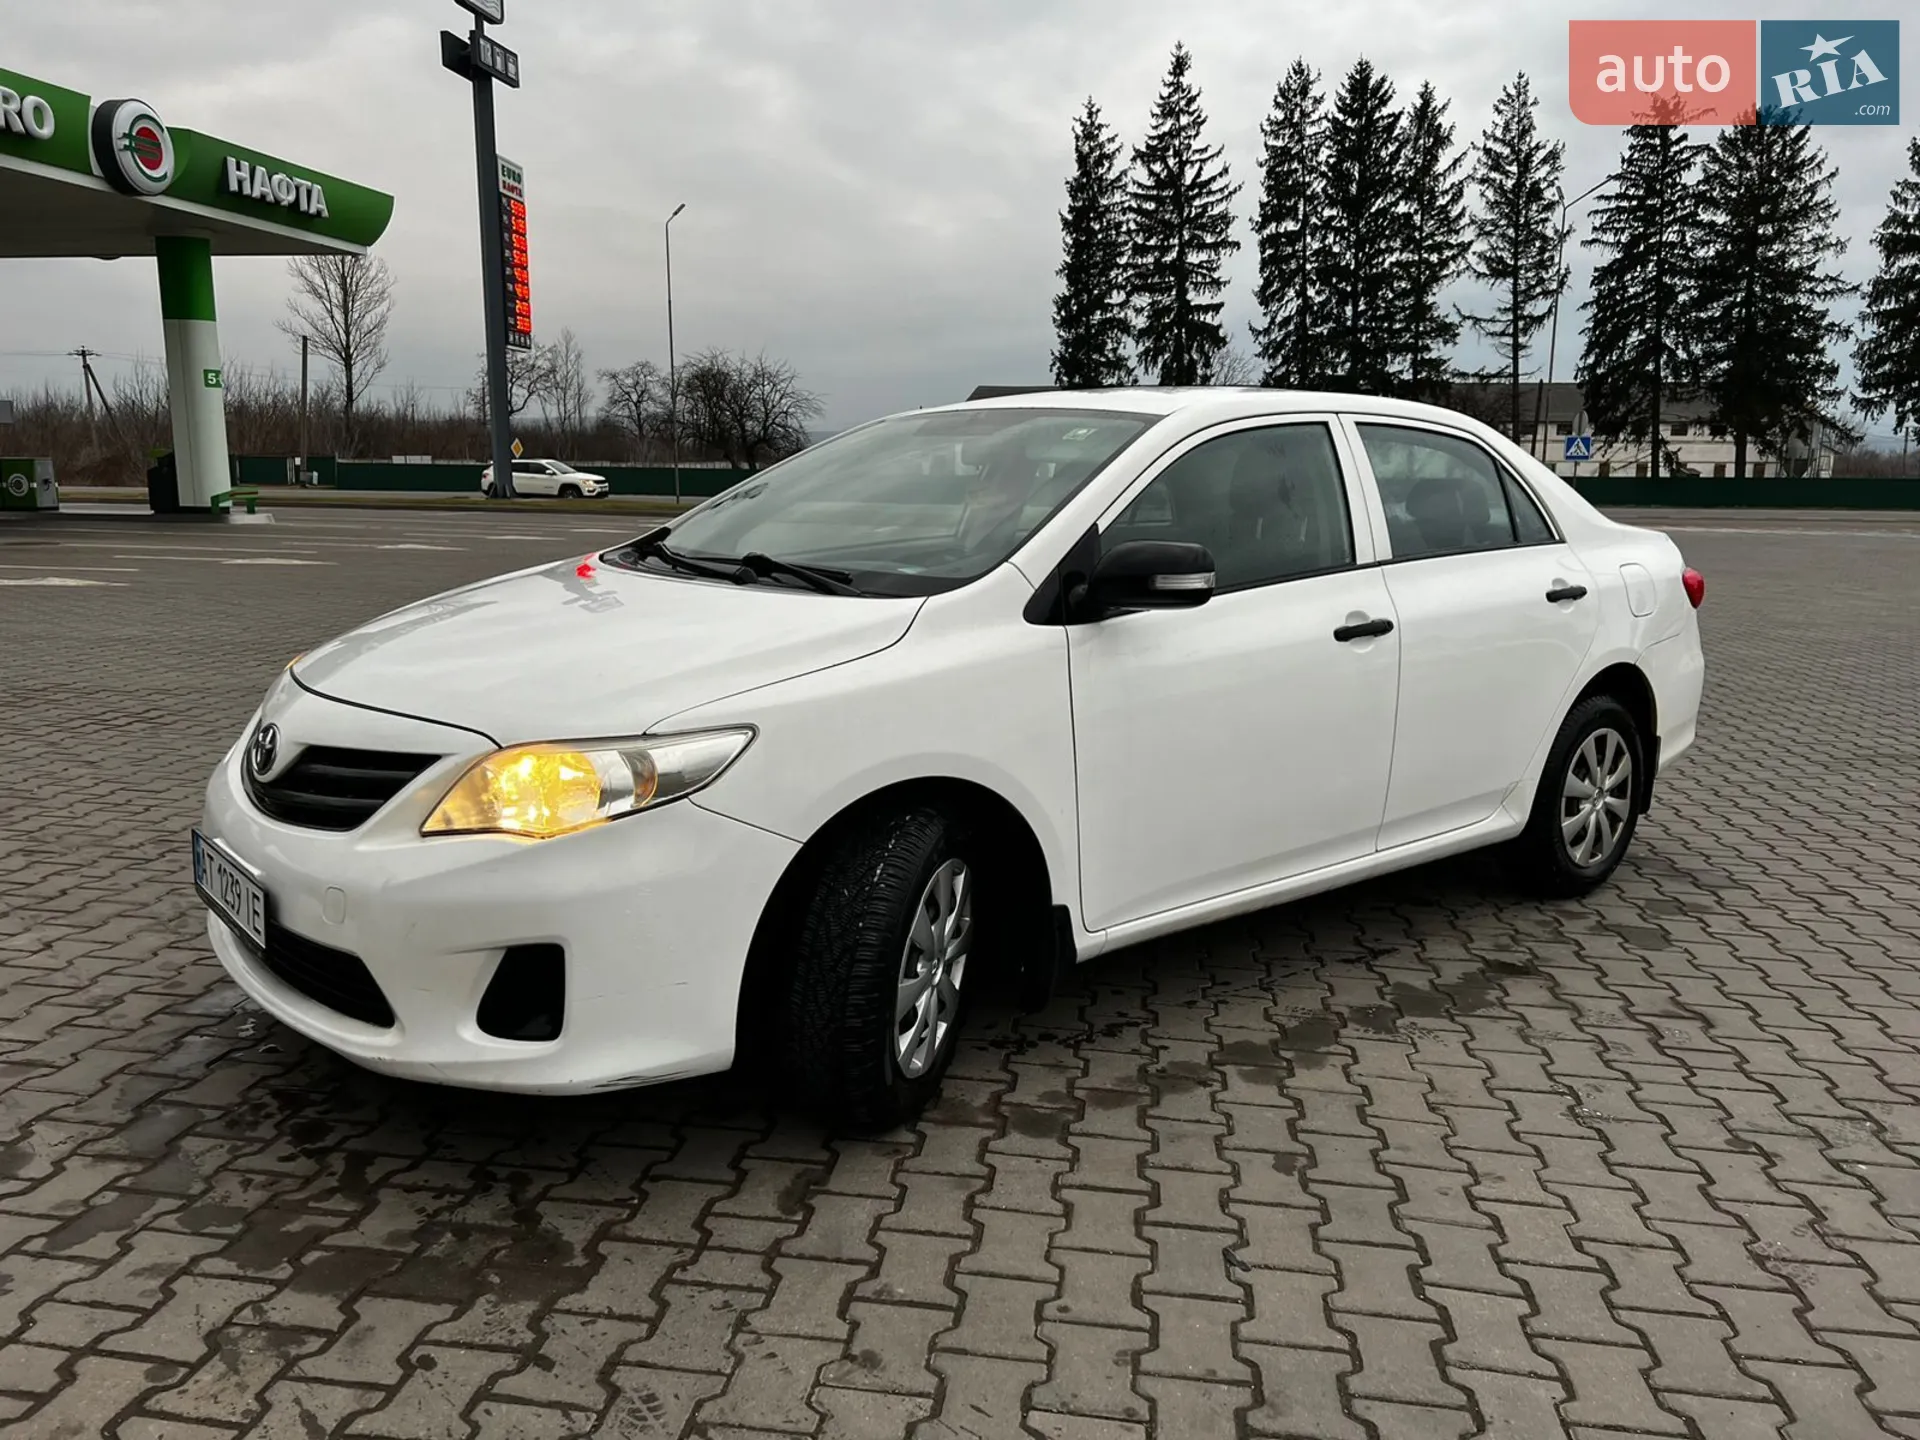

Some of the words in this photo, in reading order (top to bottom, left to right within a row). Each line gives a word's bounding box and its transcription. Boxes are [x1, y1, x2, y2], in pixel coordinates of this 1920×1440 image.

[226, 156, 329, 218] НАФТА
[501, 164, 522, 185] EURO
[217, 863, 242, 916] 1239
[246, 887, 262, 937] IE
